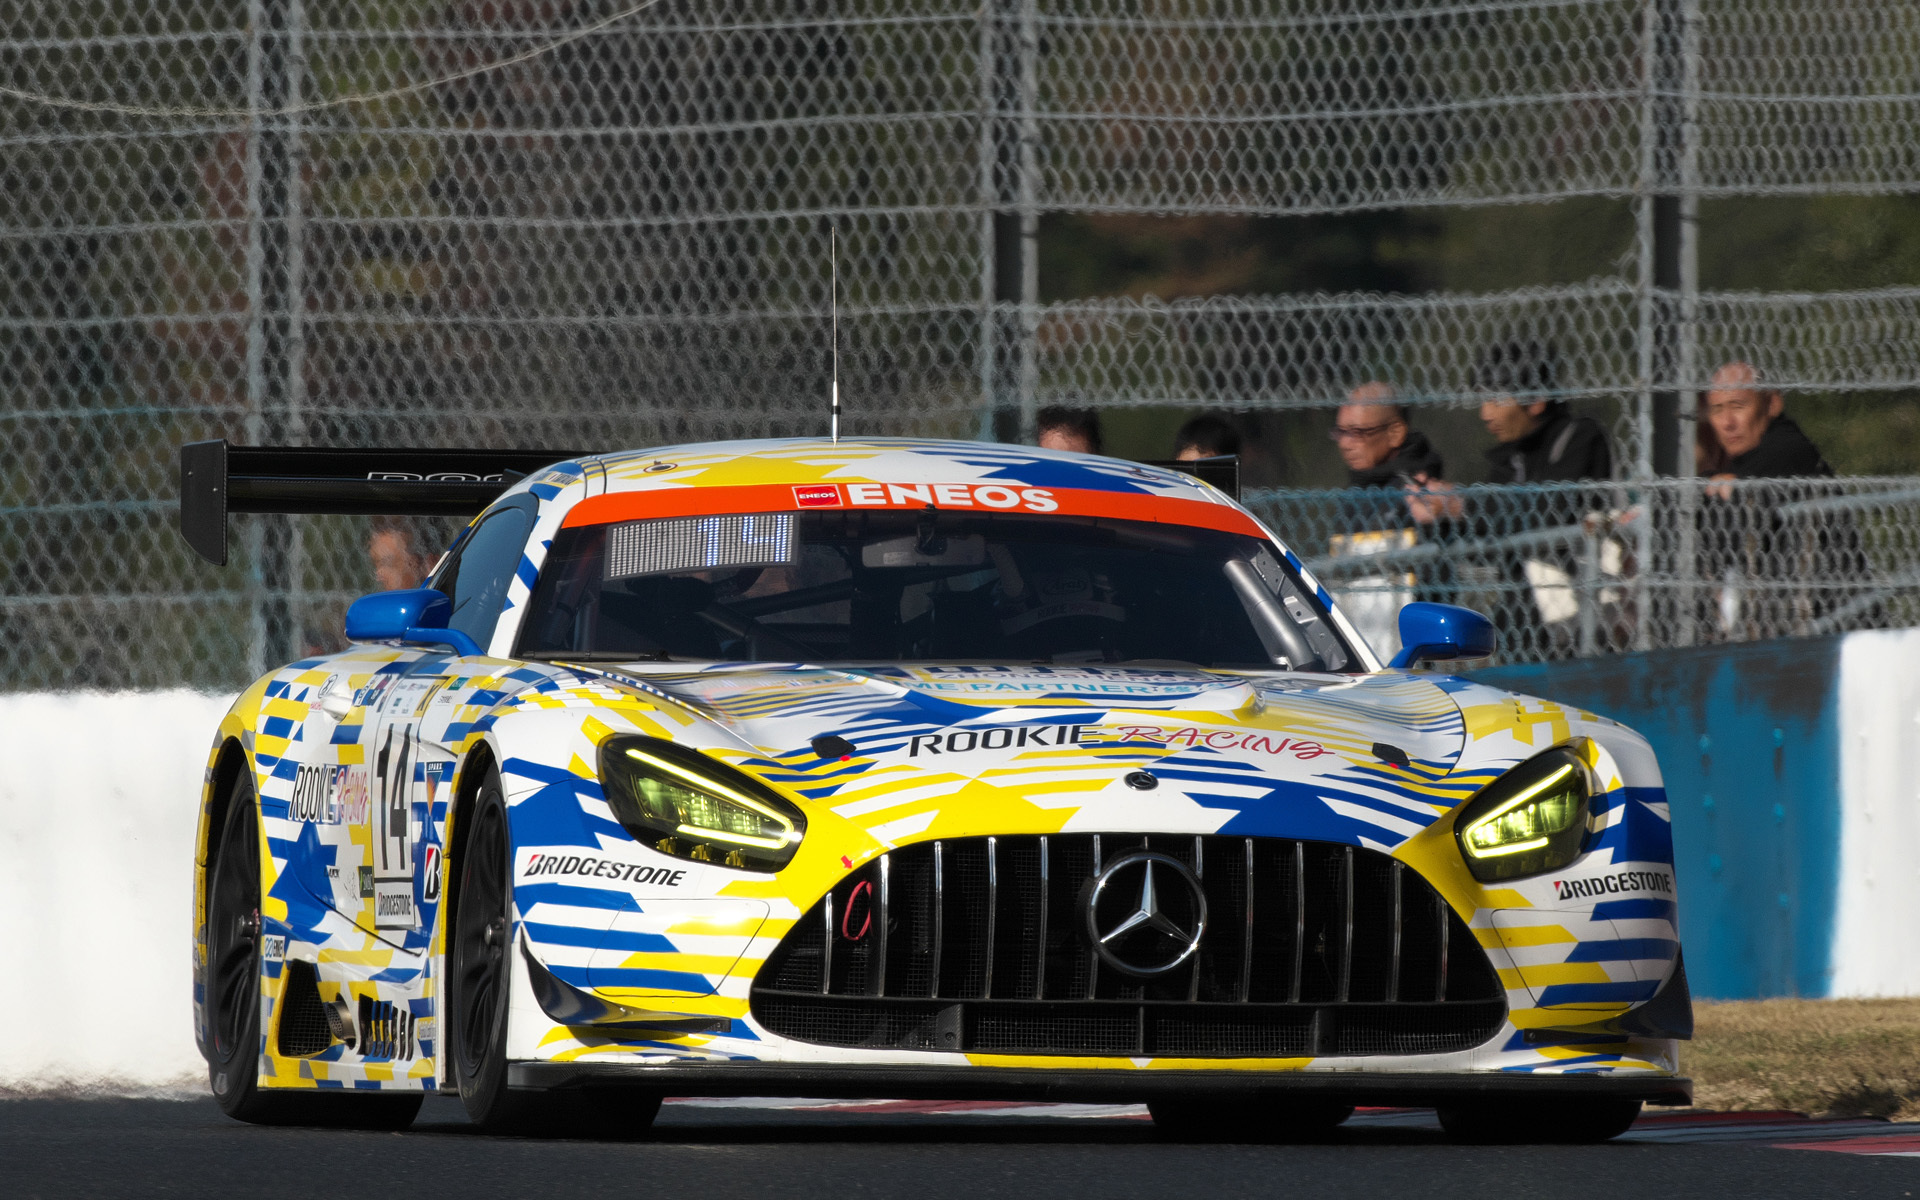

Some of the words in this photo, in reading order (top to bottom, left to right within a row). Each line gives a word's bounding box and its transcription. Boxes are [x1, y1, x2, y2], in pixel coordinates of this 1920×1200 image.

[798, 492, 836, 500] ENEOS
[846, 482, 1059, 513] ENEOS
[970, 683, 1152, 693] PARTNER
[908, 723, 1105, 758] ROOKIE
[1116, 725, 1335, 760] RACING
[289, 764, 337, 822] ROOKIE
[376, 723, 412, 870] 14
[524, 854, 687, 887] BRIDGESTONE
[1553, 872, 1672, 900] BRIDGESTONE
[378, 891, 412, 917] BRIDGESTONE
